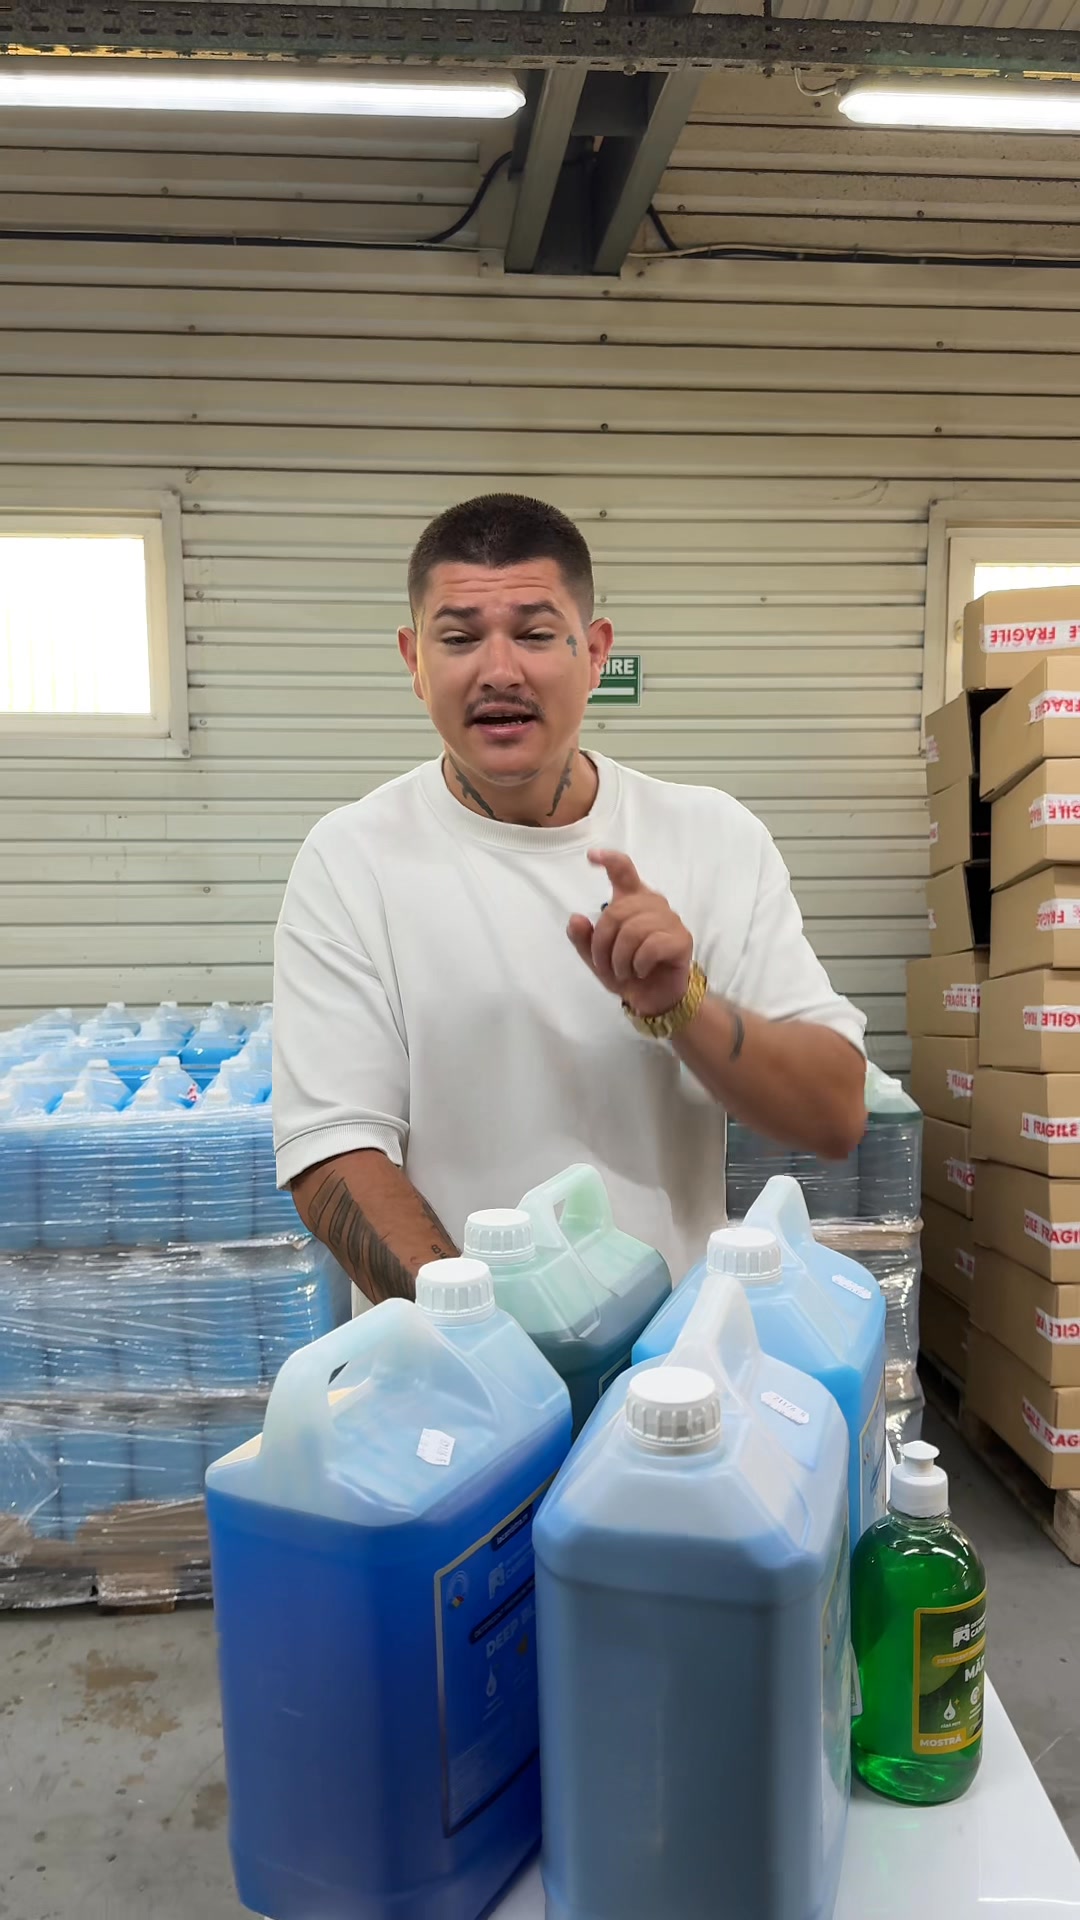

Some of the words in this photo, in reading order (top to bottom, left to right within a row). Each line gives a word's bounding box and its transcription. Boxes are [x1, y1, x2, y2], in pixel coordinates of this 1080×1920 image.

[990, 627, 1056, 643] FRAGILE
[1034, 1121, 1077, 1138] FRAGILE
[486, 1617, 519, 1660] DEEP
[919, 1733, 963, 1748] MOSTRĂ
